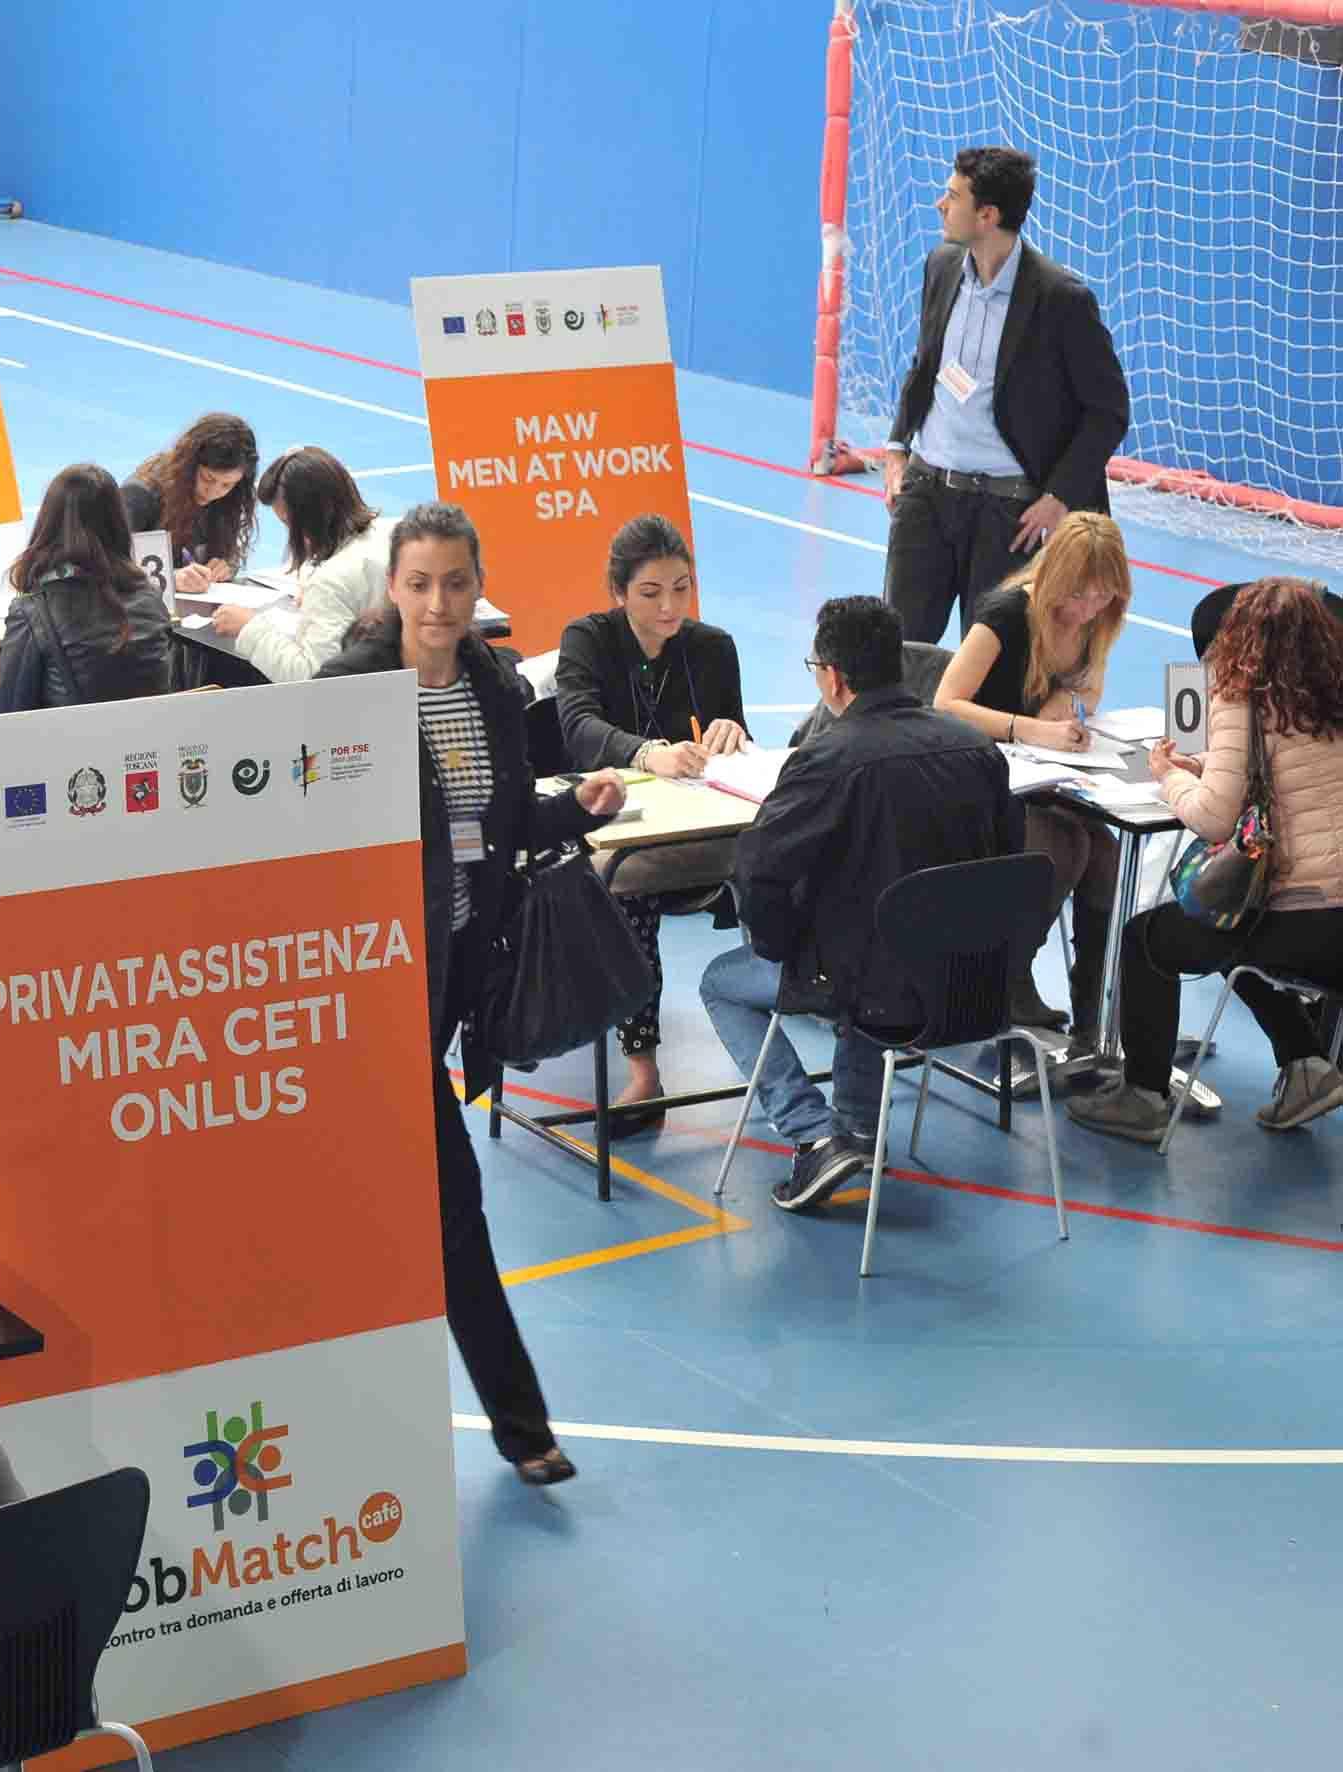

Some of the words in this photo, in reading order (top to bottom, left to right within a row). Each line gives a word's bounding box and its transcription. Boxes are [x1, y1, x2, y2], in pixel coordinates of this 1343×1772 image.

[513, 411, 599, 447] MAW
[448, 454, 518, 489] MEN
[526, 452, 566, 484] AT
[573, 443, 673, 481] WORK
[535, 488, 599, 521] SPA
[331, 745, 350, 757] POR
[352, 743, 369, 755] FSE
[58, 1016, 207, 1085] MIRA
[224, 992, 348, 1057] CETI
[110, 1066, 307, 1142] ONLUS
[122, 1516, 363, 1614] obMatch
[360, 1500, 400, 1530] café
[160, 1620, 182, 1638] tra
[187, 1601, 264, 1630] domanda
[267, 1597, 277, 1611] e
[281, 1584, 333, 1609] offerta
[337, 1578, 352, 1593] di
[356, 1566, 405, 1590] lavoro
